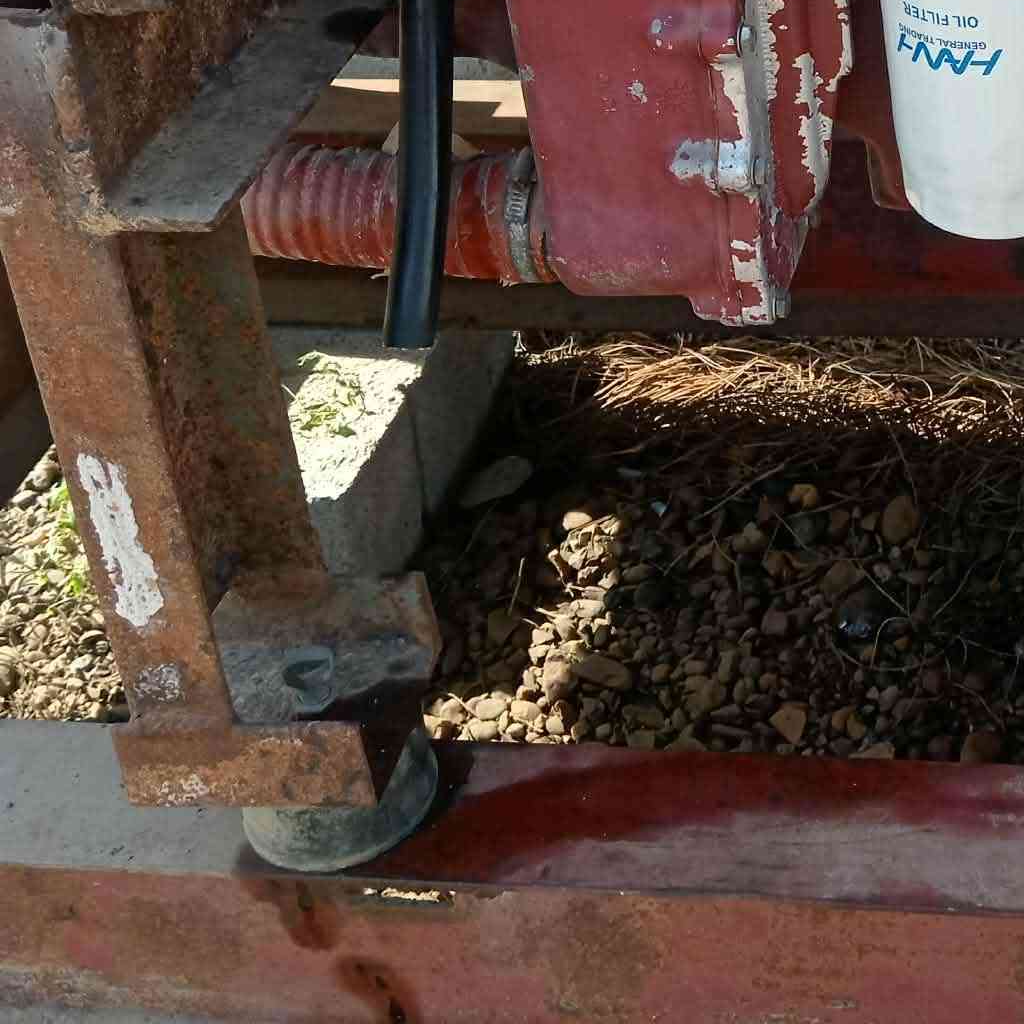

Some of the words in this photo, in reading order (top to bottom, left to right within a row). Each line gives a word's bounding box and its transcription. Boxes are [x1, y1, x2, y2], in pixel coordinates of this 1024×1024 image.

[903, 1, 949, 26] FILTER
[952, 15, 978, 29] OIL
[898, 22, 935, 45] TRADING
[936, 38, 987, 50] GENERAL
